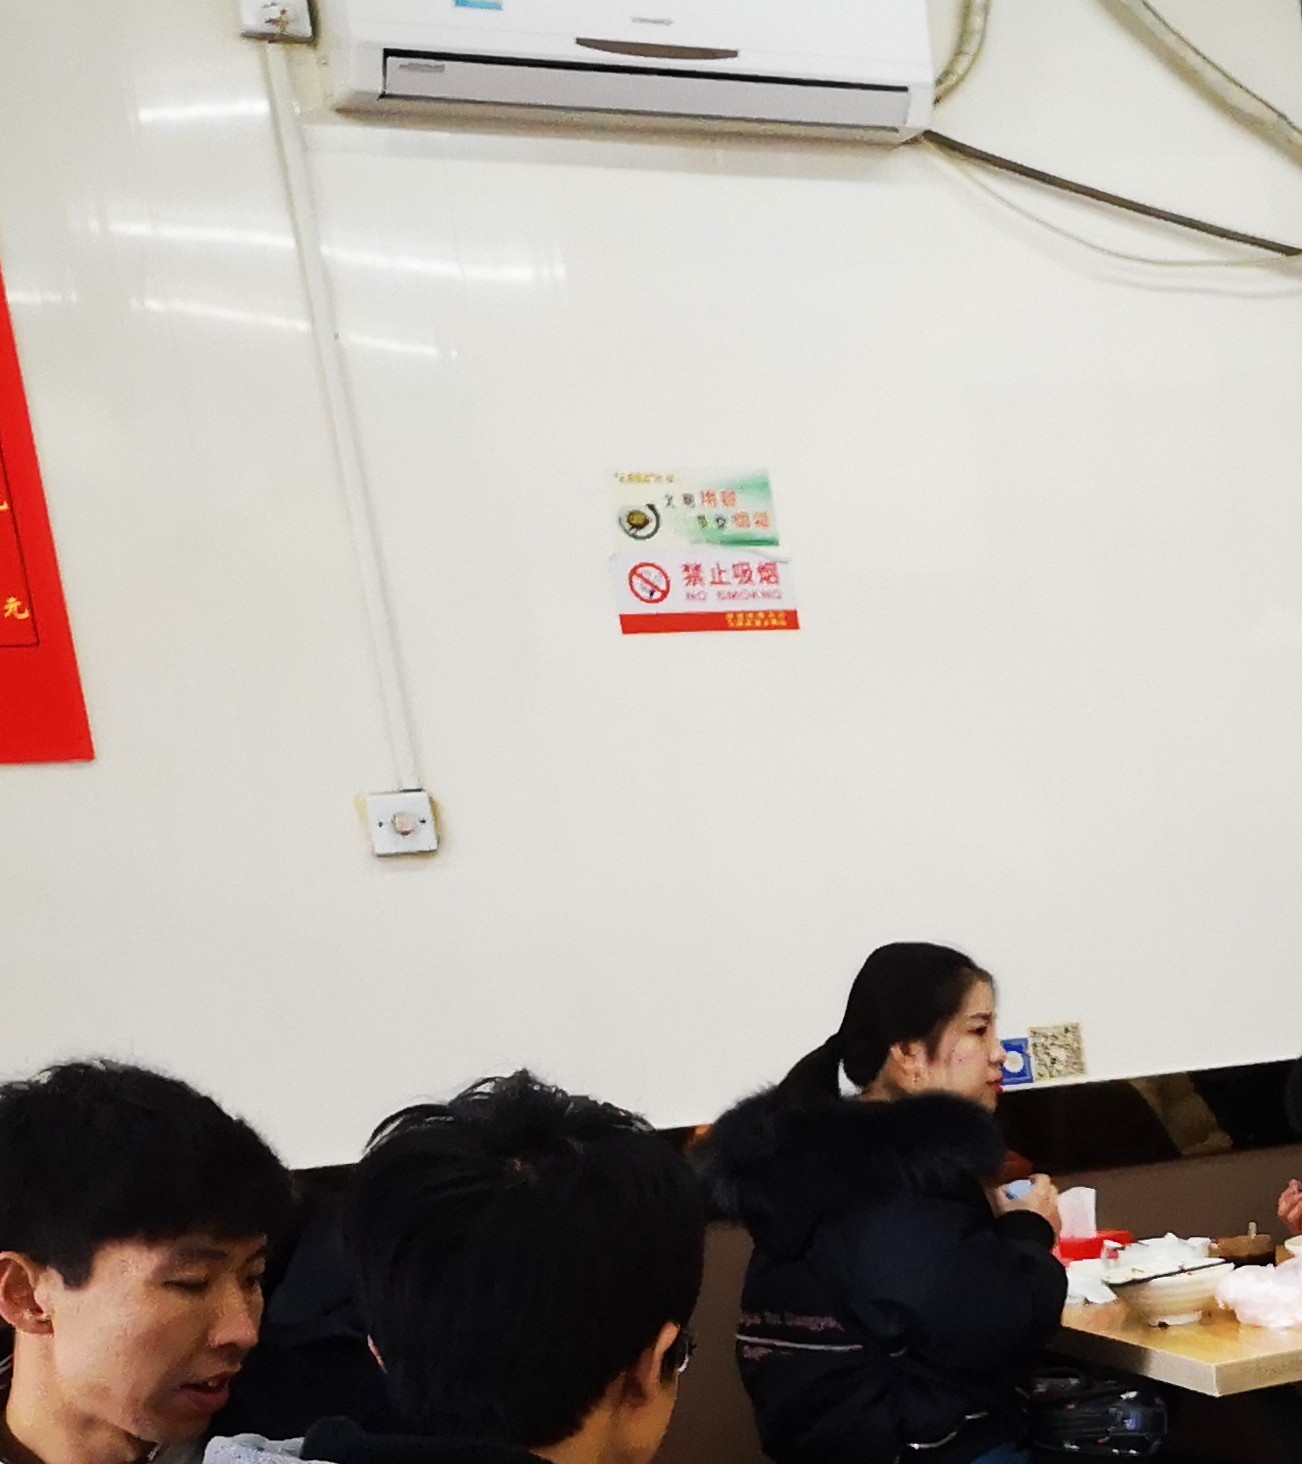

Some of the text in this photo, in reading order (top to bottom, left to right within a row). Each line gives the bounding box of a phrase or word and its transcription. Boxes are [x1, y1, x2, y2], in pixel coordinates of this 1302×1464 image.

[681, 561, 780, 587] 禁止吸烟
[4, 596, 30, 620] 元
